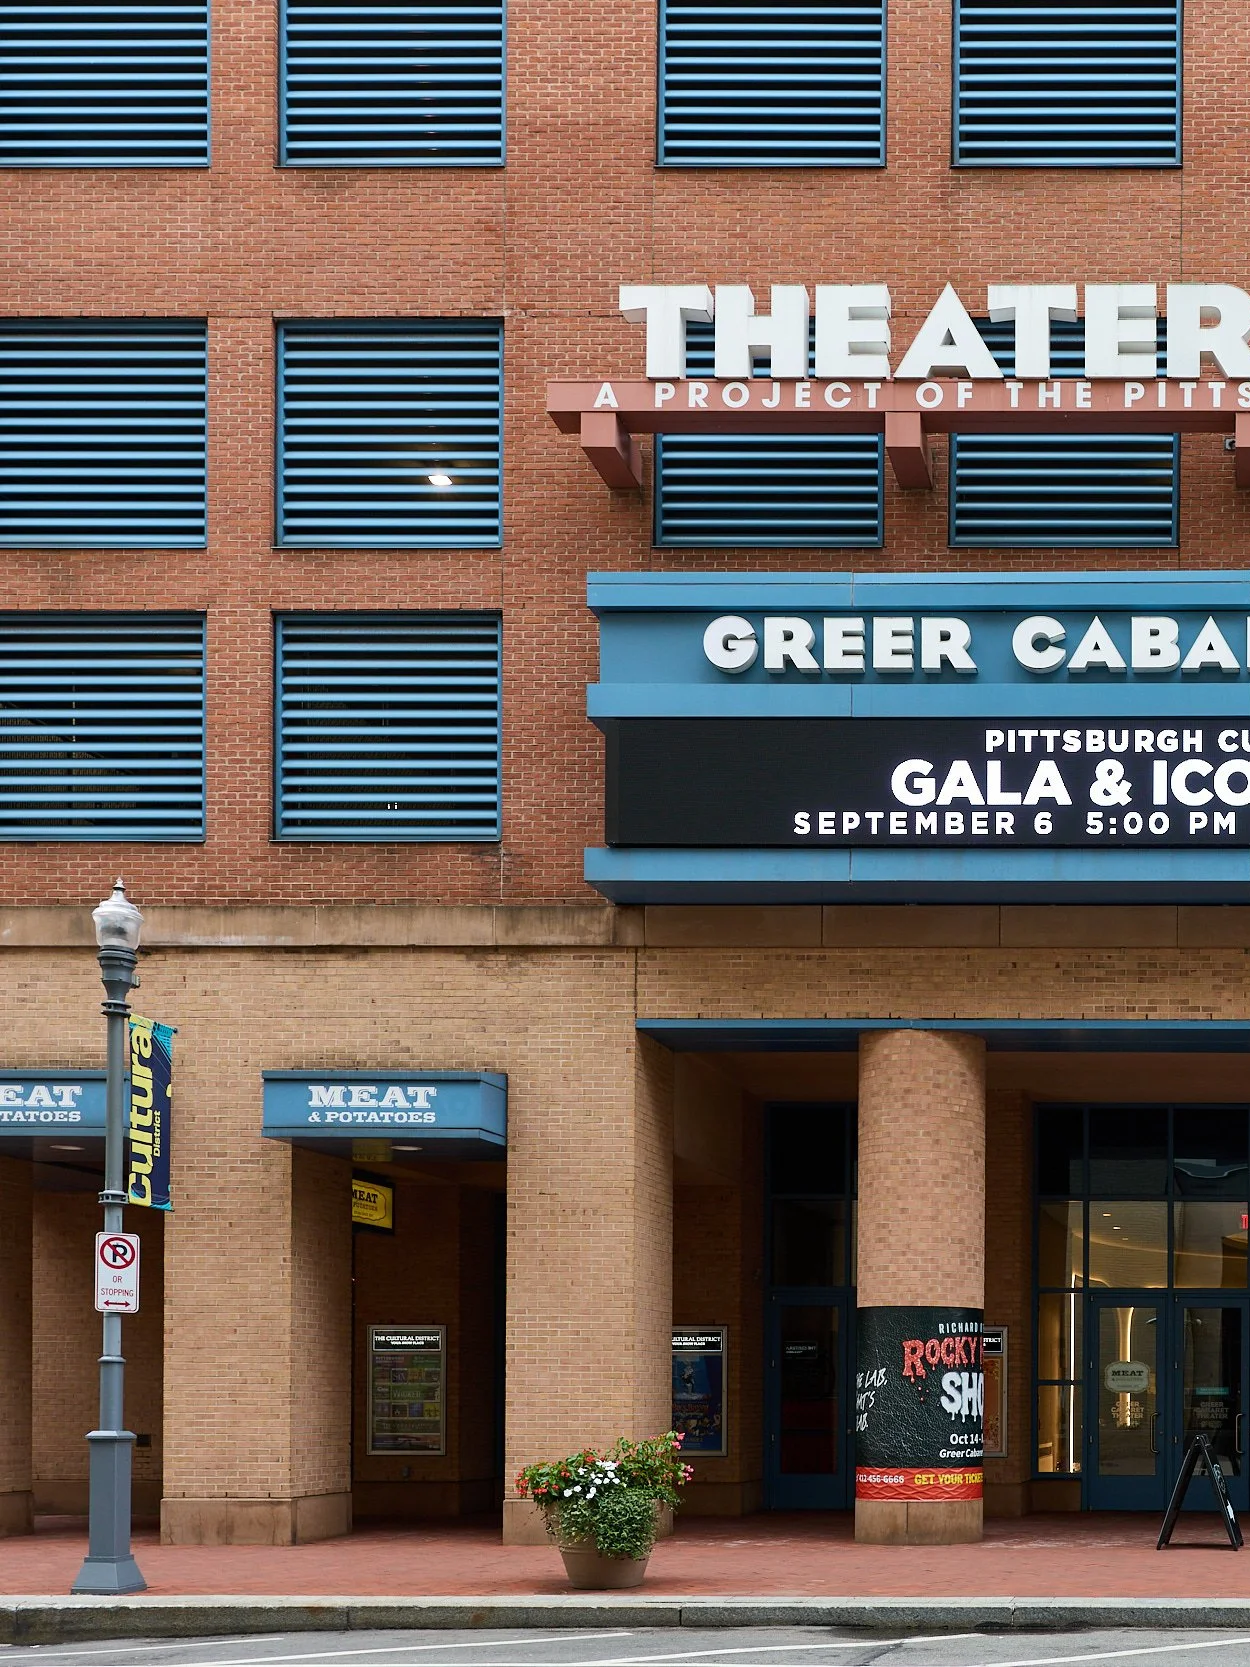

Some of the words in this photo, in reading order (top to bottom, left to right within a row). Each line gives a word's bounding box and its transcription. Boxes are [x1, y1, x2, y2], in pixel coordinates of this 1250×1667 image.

[593, 382, 619, 408] A
[654, 382, 883, 409] PROJECT
[916, 382, 974, 409] OF
[1005, 382, 1093, 409] THE
[703, 615, 978, 674] GREER
[985, 729, 1203, 753] PITTSBURGH
[890, 758, 1073, 807] GALA
[1089, 758, 1133, 807] &
[793, 811, 1015, 835] SEPTEMBER
[1033, 811, 1053, 835] 6
[1085, 811, 1170, 835] 5:00
[1189, 811, 1236, 835] PM
[308, 1085, 437, 1109] MEAT
[308, 1111, 321, 1123] &
[325, 1111, 436, 1123] POTATOES
[153, 1110, 161, 1157] District
[112, 1275, 123, 1283] OR
[100, 1287, 135, 1297] STOPPING
[938, 1322, 979, 1334] RICHARD
[902, 1336, 978, 1383] ROCKY
[1111, 1369, 1144, 1377] MEAT
[949, 1433, 969, 1445] Oct
[939, 1448, 965, 1459] Greer
[913, 1474, 935, 1485] GET
[939, 1473, 964, 1484] YOUR
